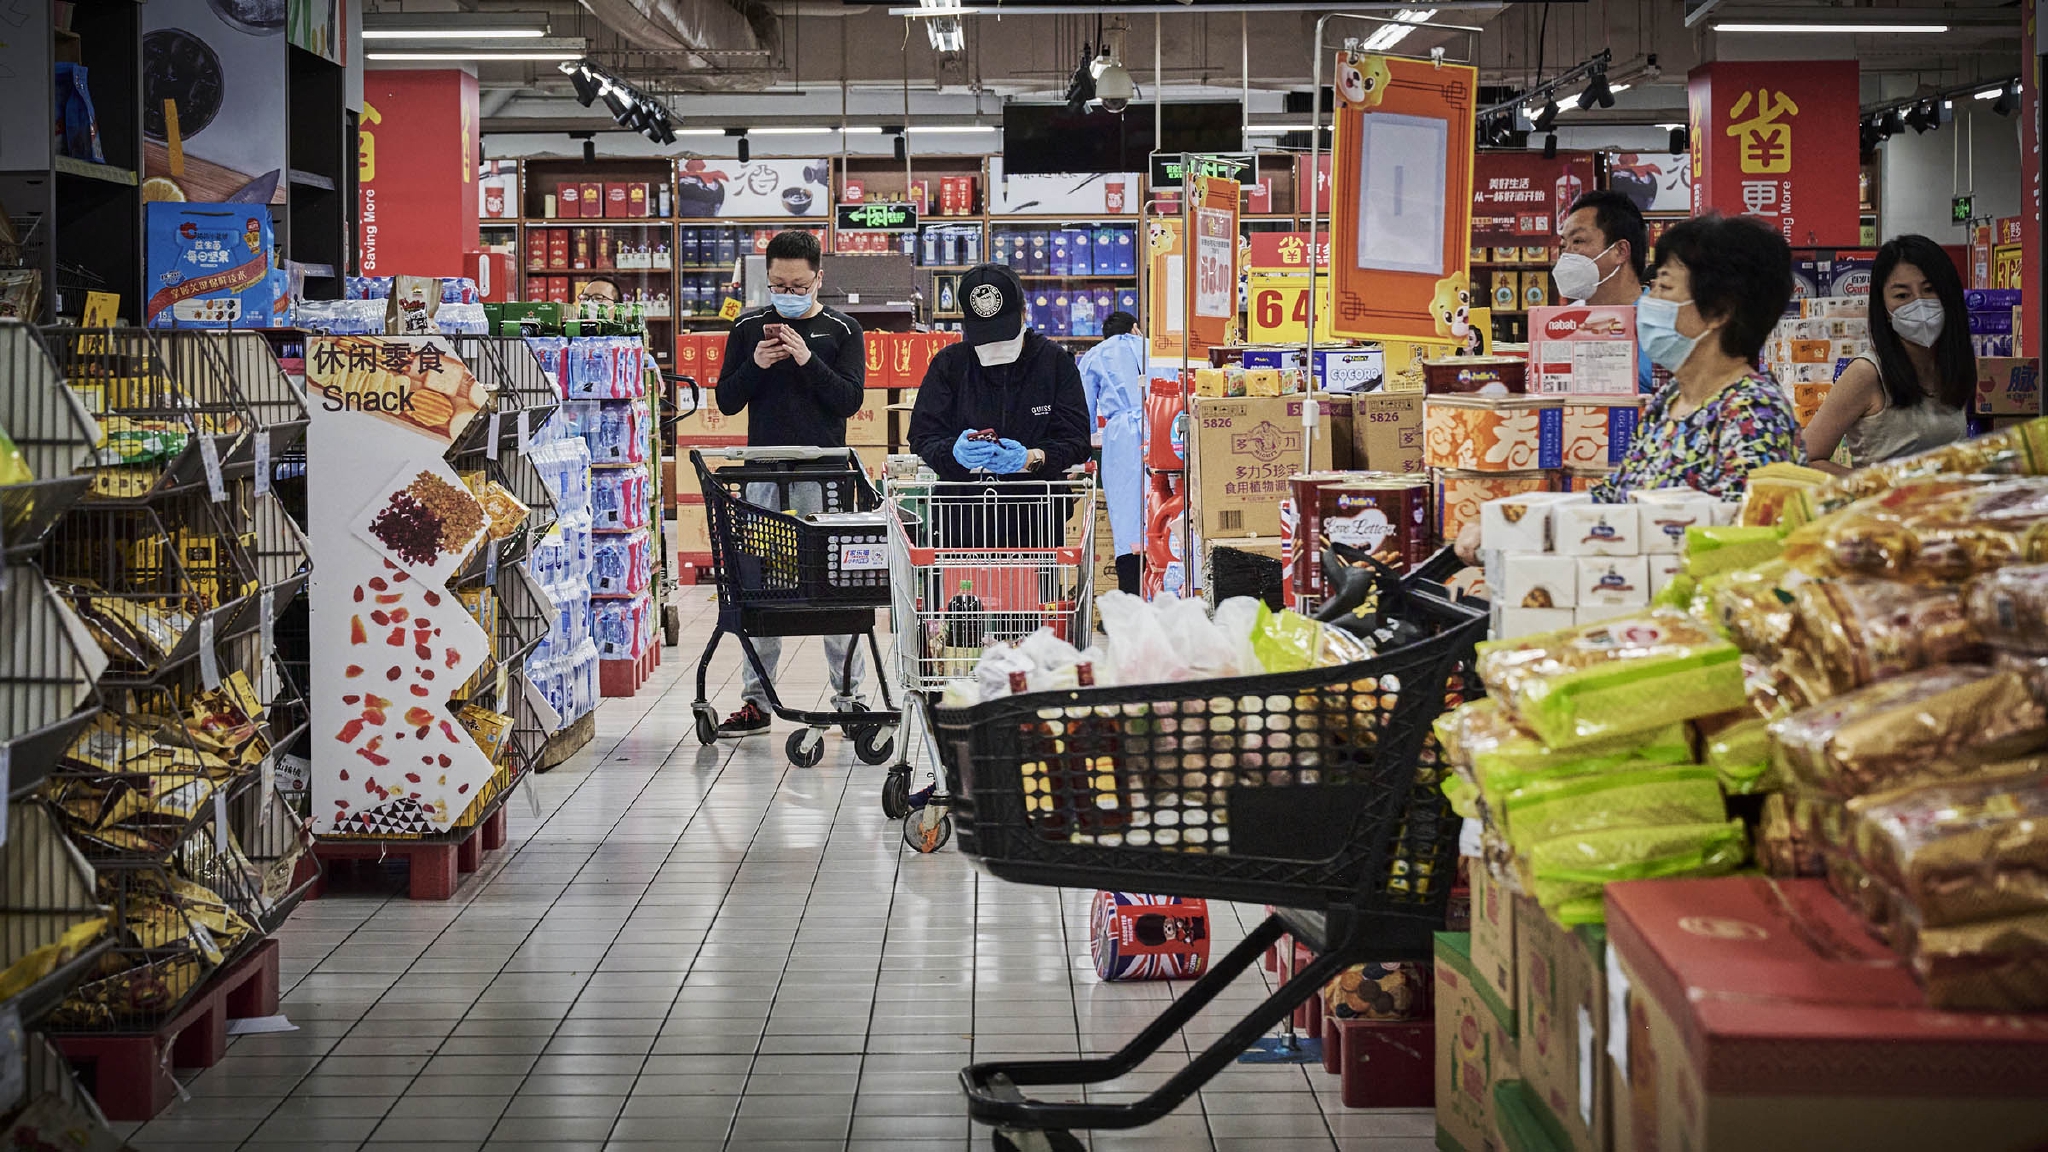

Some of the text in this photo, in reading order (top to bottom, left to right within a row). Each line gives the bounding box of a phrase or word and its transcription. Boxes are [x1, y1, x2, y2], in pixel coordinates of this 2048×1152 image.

[1726, 88, 1799, 173] 省
[1489, 178, 1530, 190] 美好生活
[1781, 181, 1792, 214] More
[364, 189, 376, 218] More
[1741, 181, 1778, 217] 更
[364, 222, 378, 270] Saving
[1278, 236, 1304, 264] 省
[1548, 319, 1577, 330] nabati
[313, 341, 446, 375] 休闲零食
[1330, 367, 1379, 382] COCORO
[322, 385, 416, 412] Snack
[1203, 418, 1232, 428] 5826
[1369, 412, 1399, 423] 5826
[1236, 463, 1299, 479] 多力5珍宝
